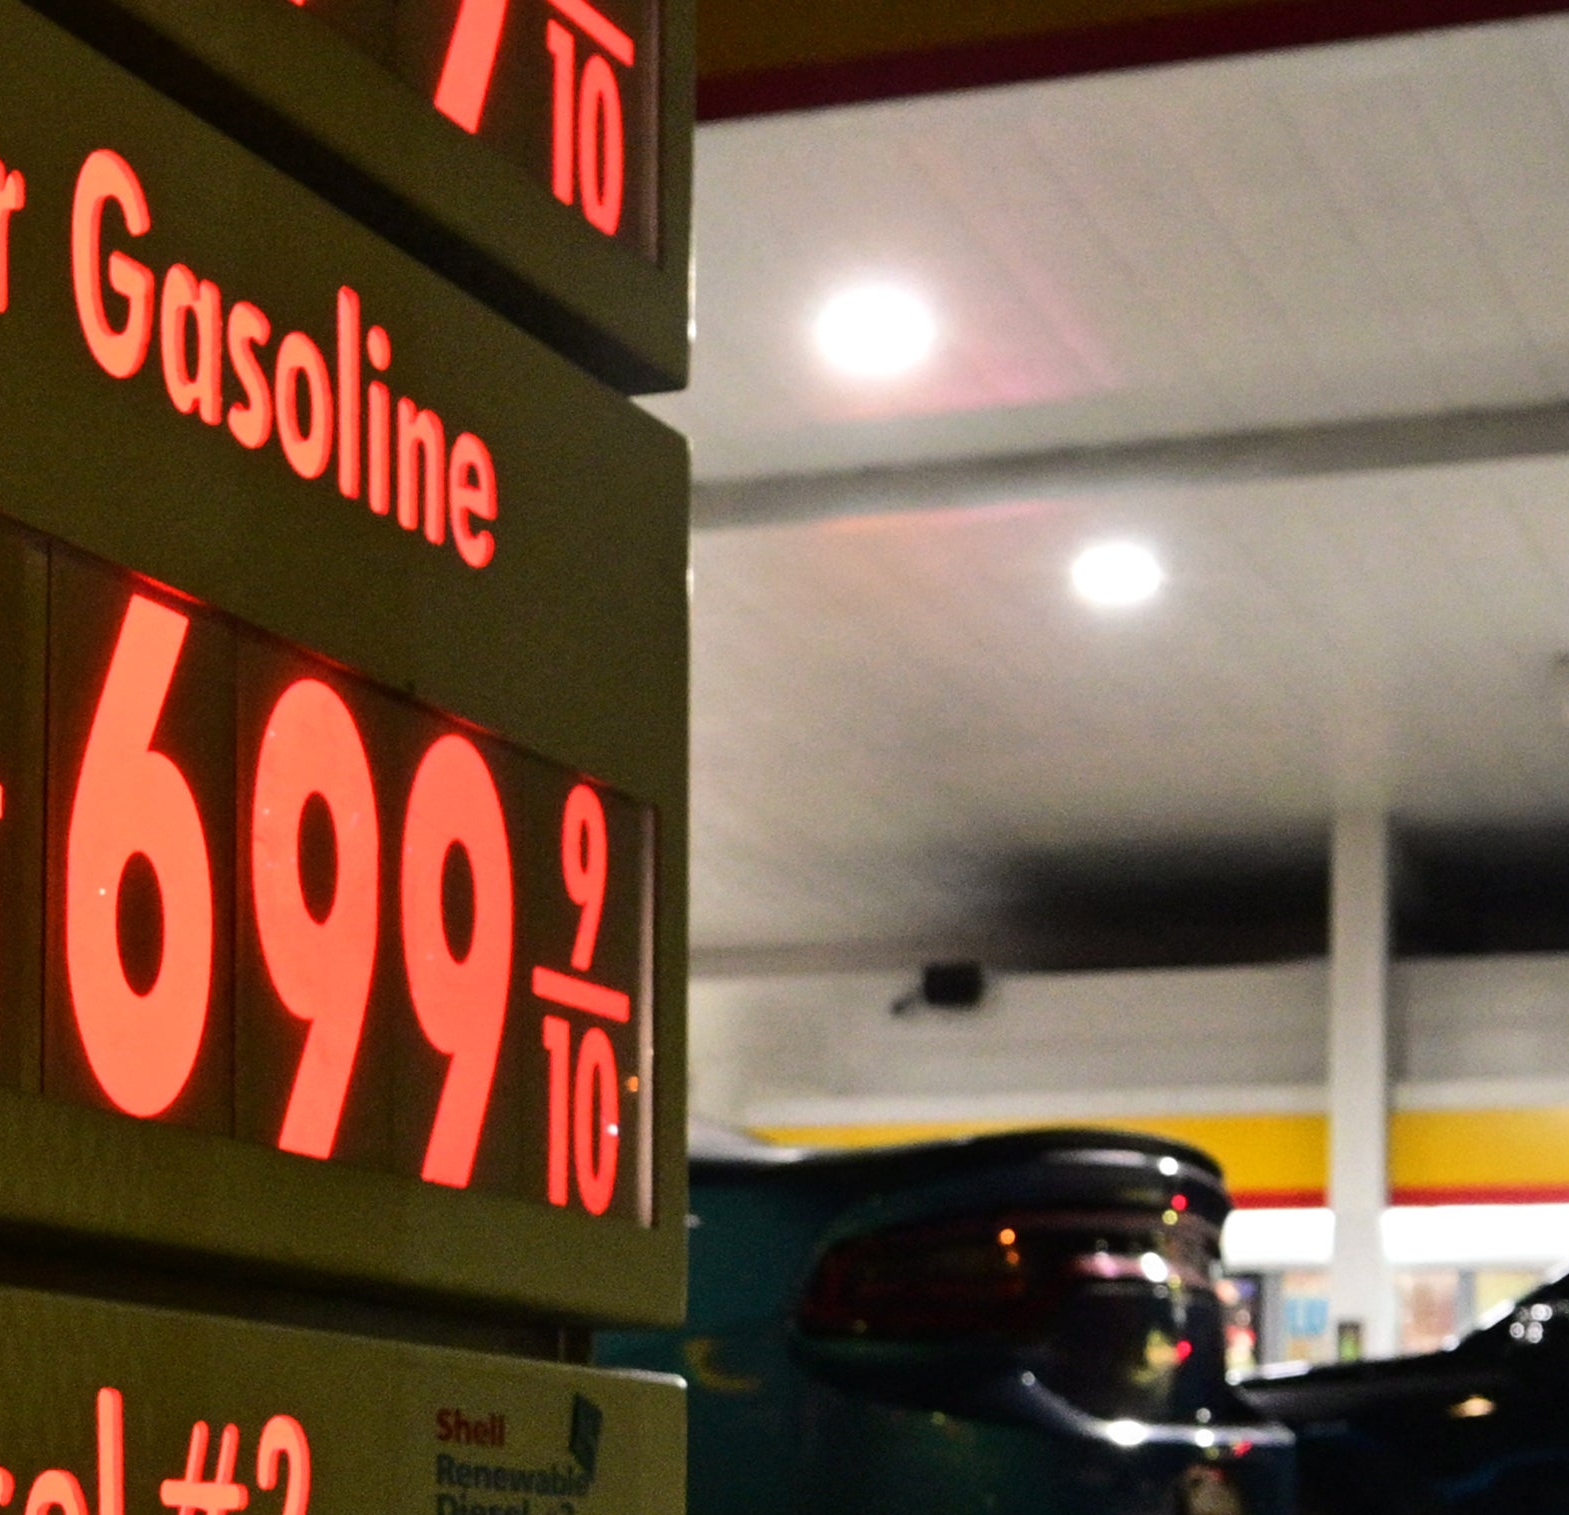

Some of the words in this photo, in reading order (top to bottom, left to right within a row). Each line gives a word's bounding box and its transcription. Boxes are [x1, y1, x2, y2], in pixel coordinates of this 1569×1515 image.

[545, 19, 625, 237] 10
[71, 149, 498, 569] Gasoline
[63, 591, 515, 1190] 699
[436, 1407, 507, 1447] Shell
